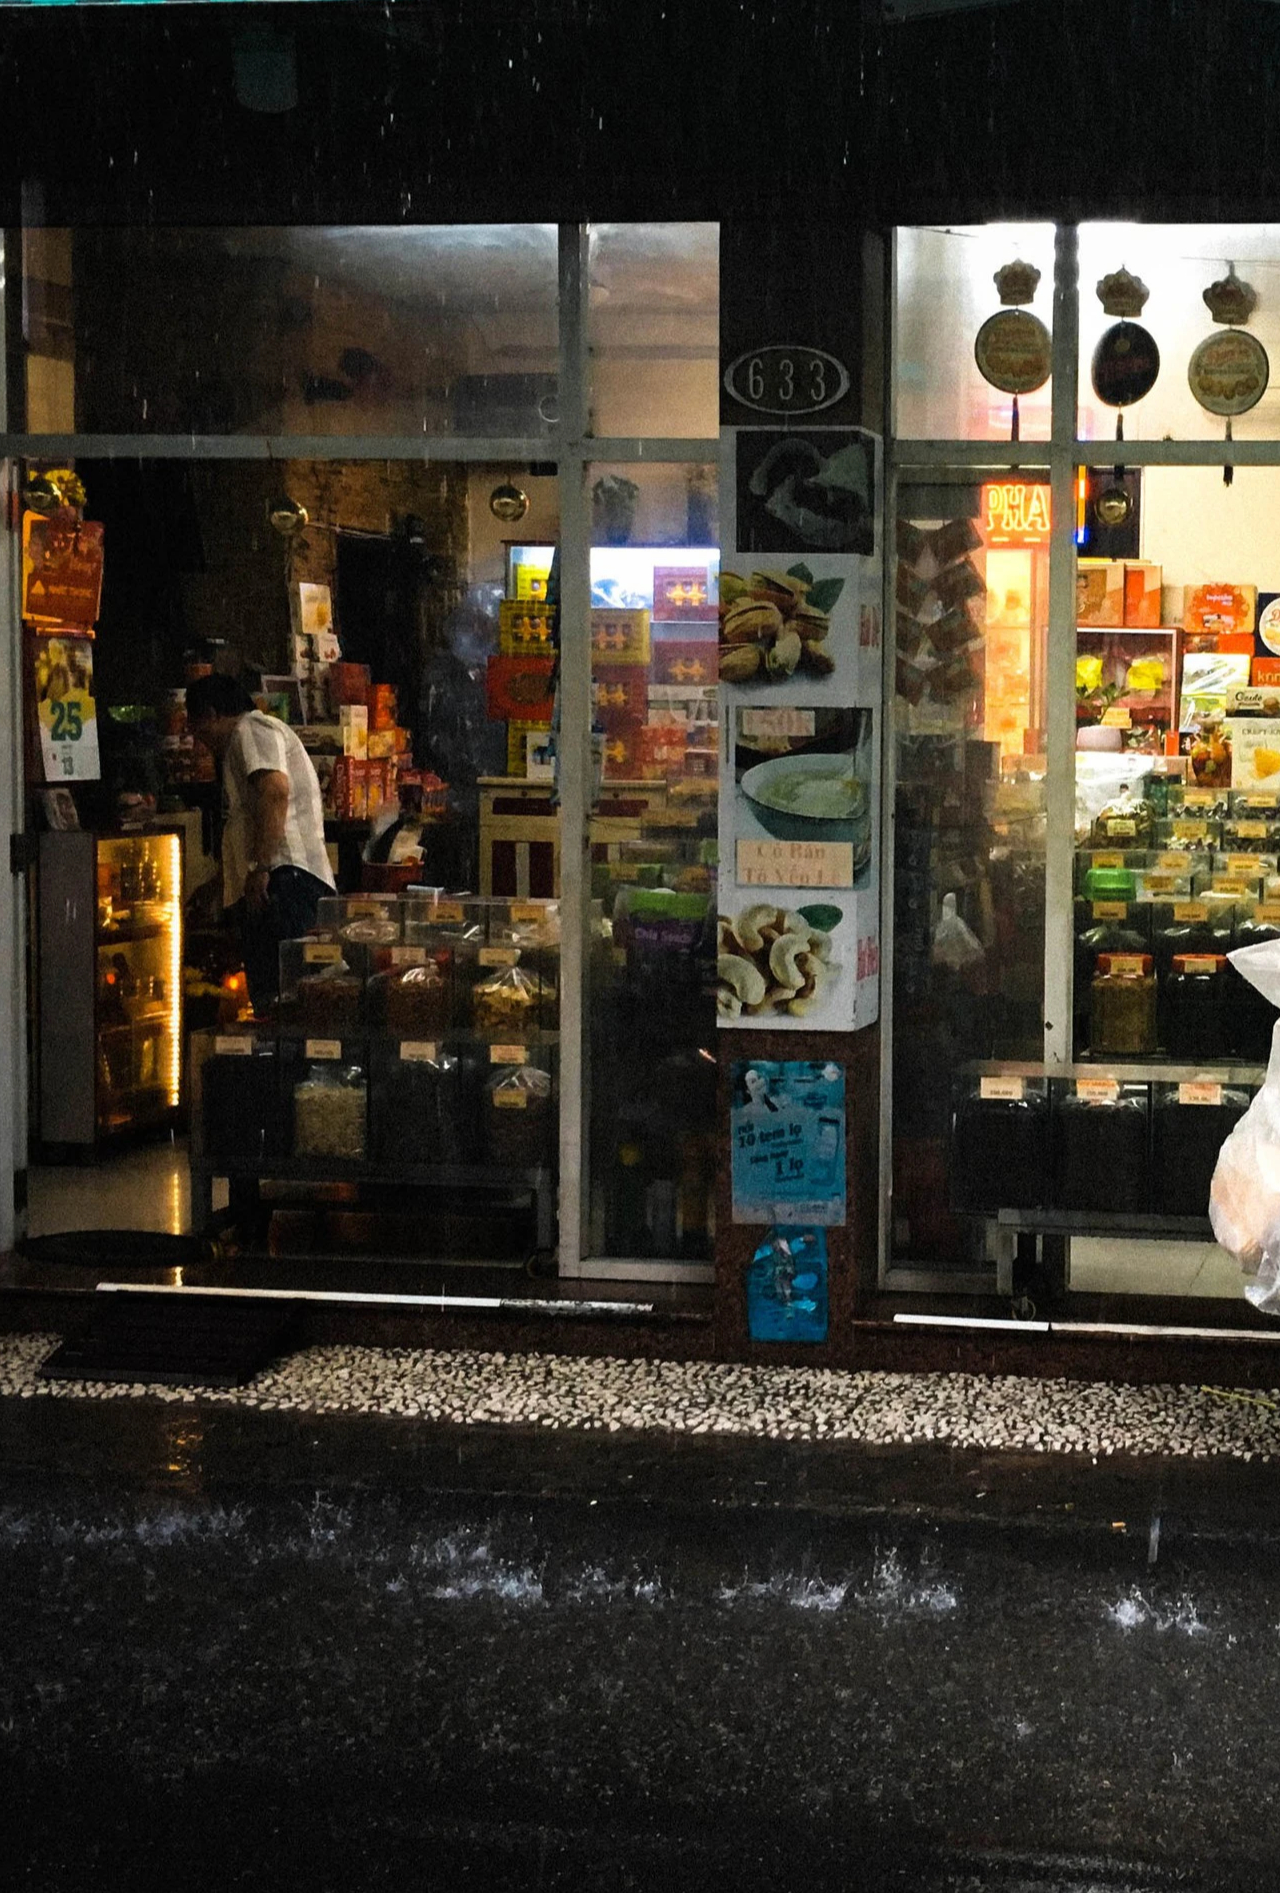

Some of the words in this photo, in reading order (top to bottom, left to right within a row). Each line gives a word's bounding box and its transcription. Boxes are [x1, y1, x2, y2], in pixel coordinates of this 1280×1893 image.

[749, 358, 826, 400] 633
[50, 701, 82, 741] 25
[62, 756, 74, 775] 13
